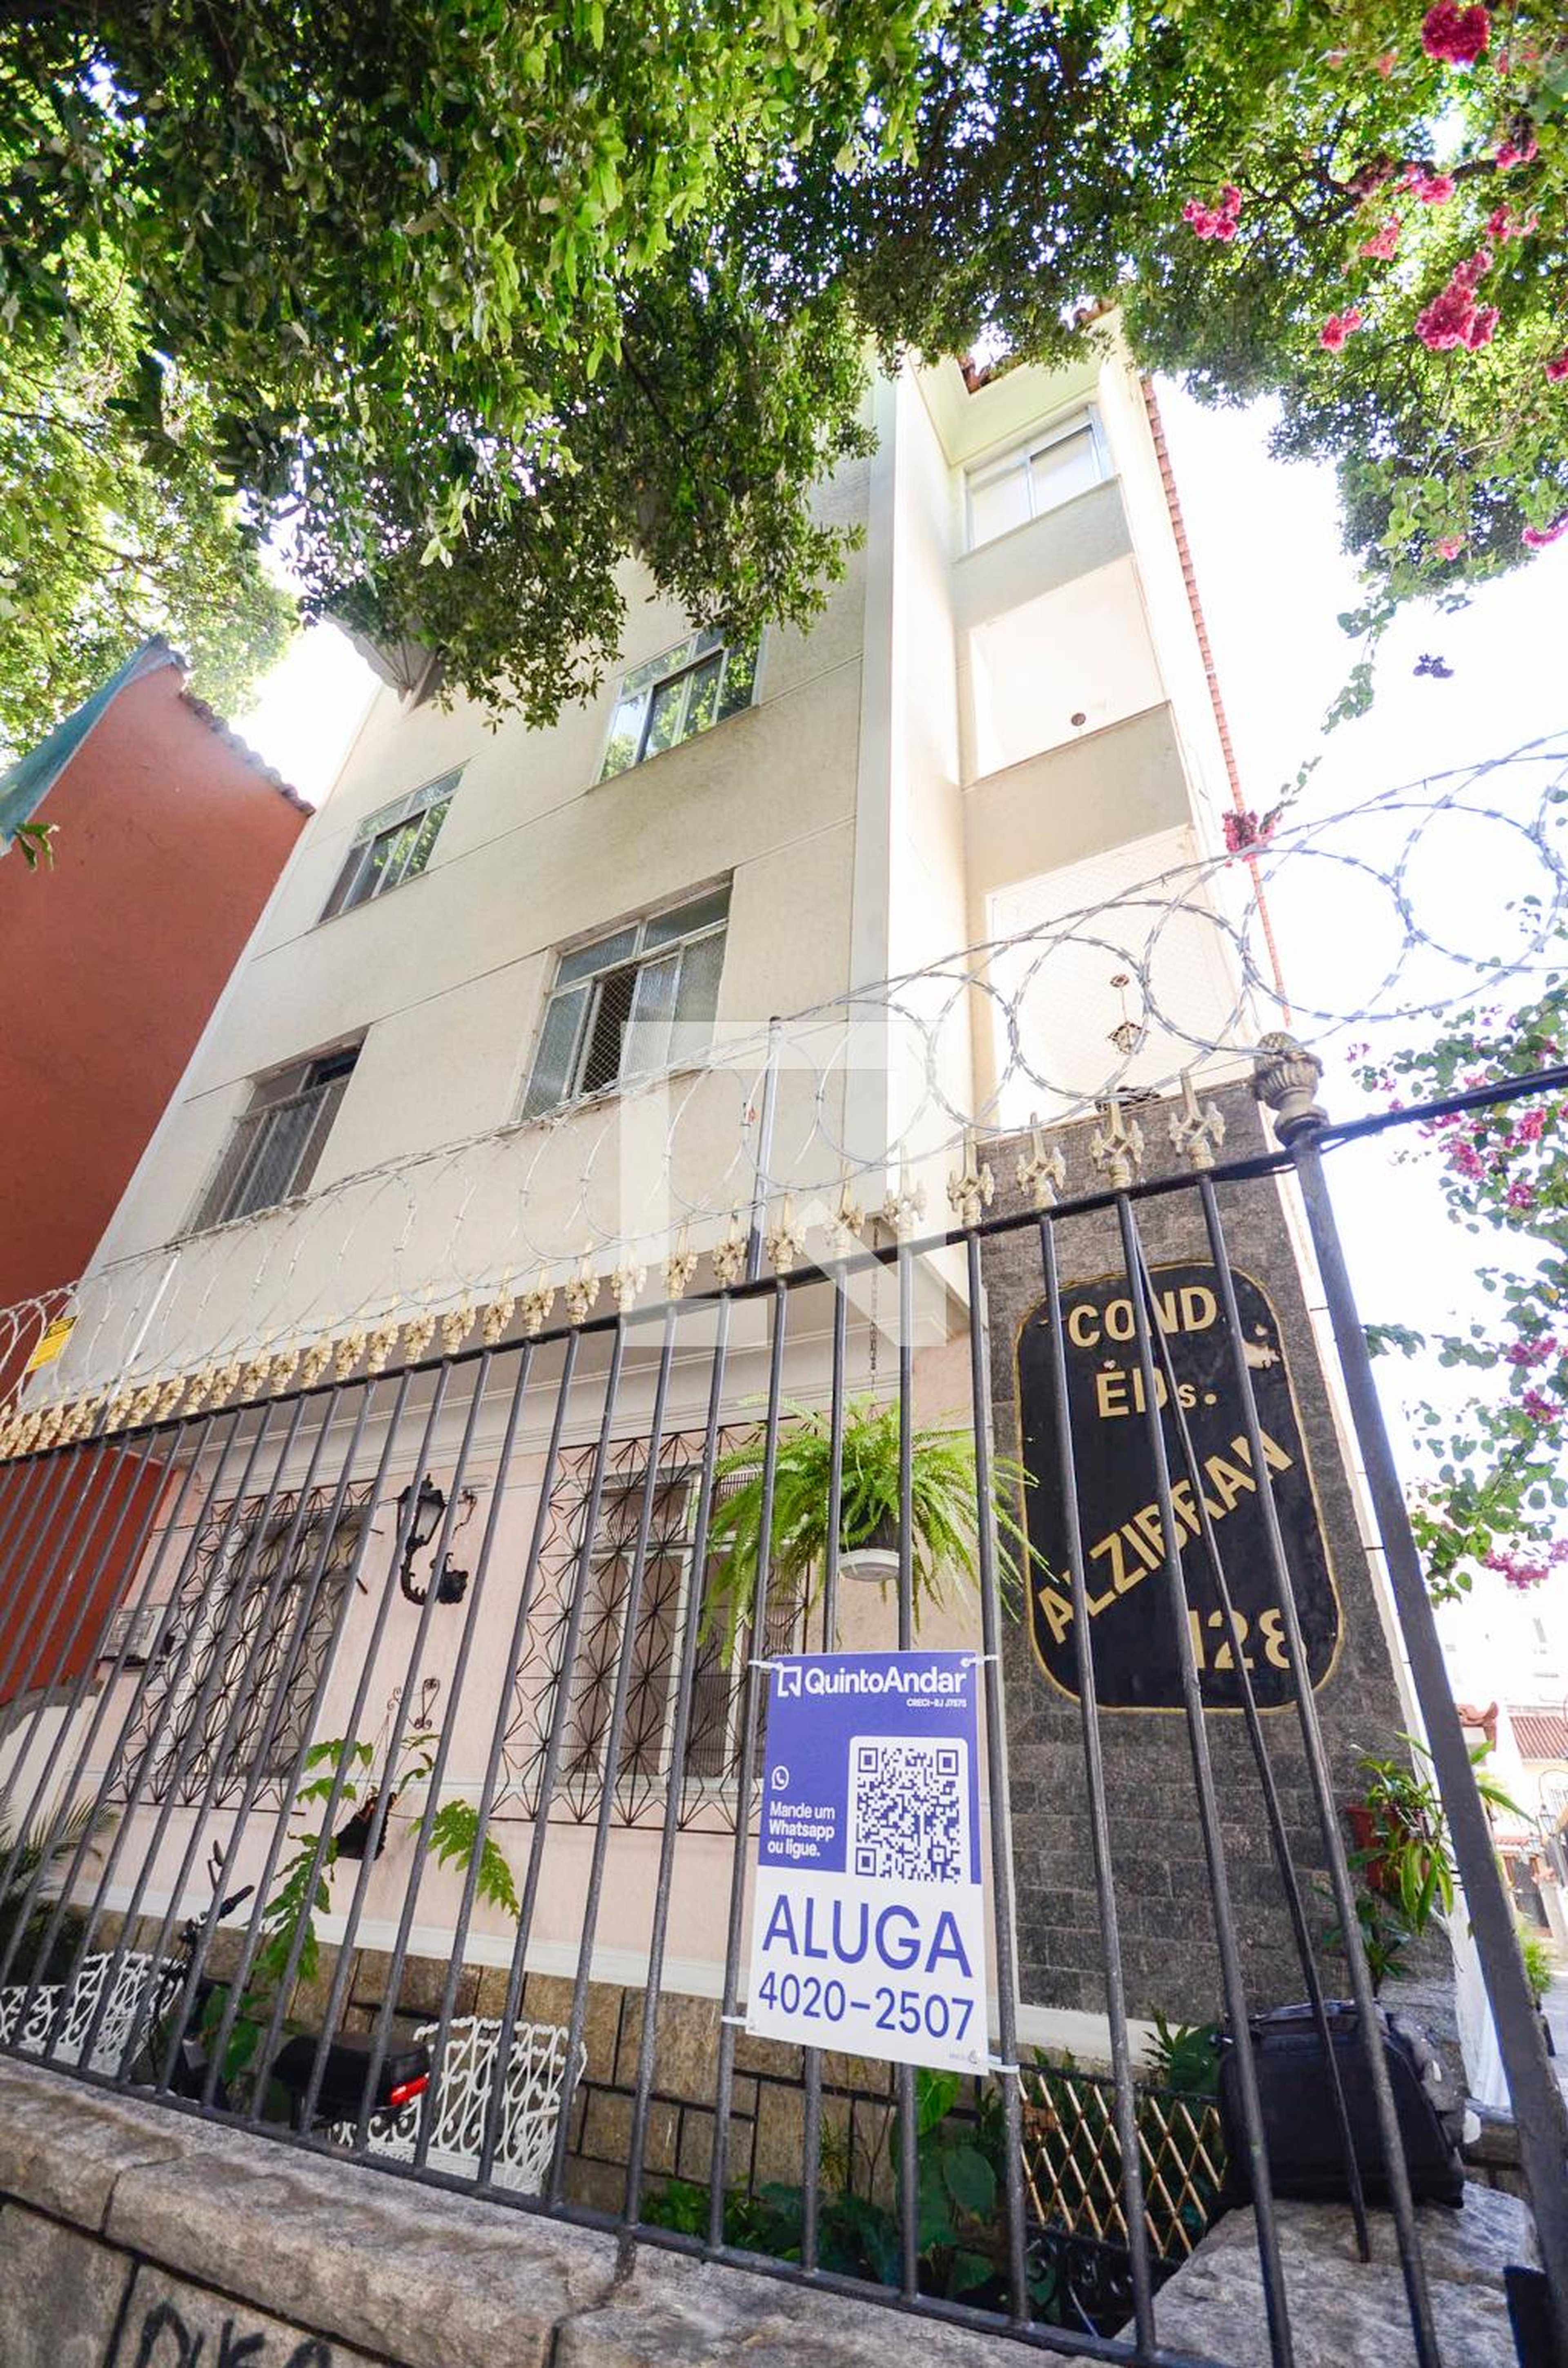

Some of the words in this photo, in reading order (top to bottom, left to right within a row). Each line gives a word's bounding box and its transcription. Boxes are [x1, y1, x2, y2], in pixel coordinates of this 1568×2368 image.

[804, 1666, 967, 1695] QuintoAndar
[769, 1800, 813, 1819] Mande
[814, 1806, 836, 1820] um
[769, 1818, 835, 1843] Whatsapp
[767, 1840, 784, 1854] ou
[785, 1837, 821, 1860] ligue.
[762, 1894, 973, 1978] ALUGA
[758, 1971, 974, 2041] 4020-2507
